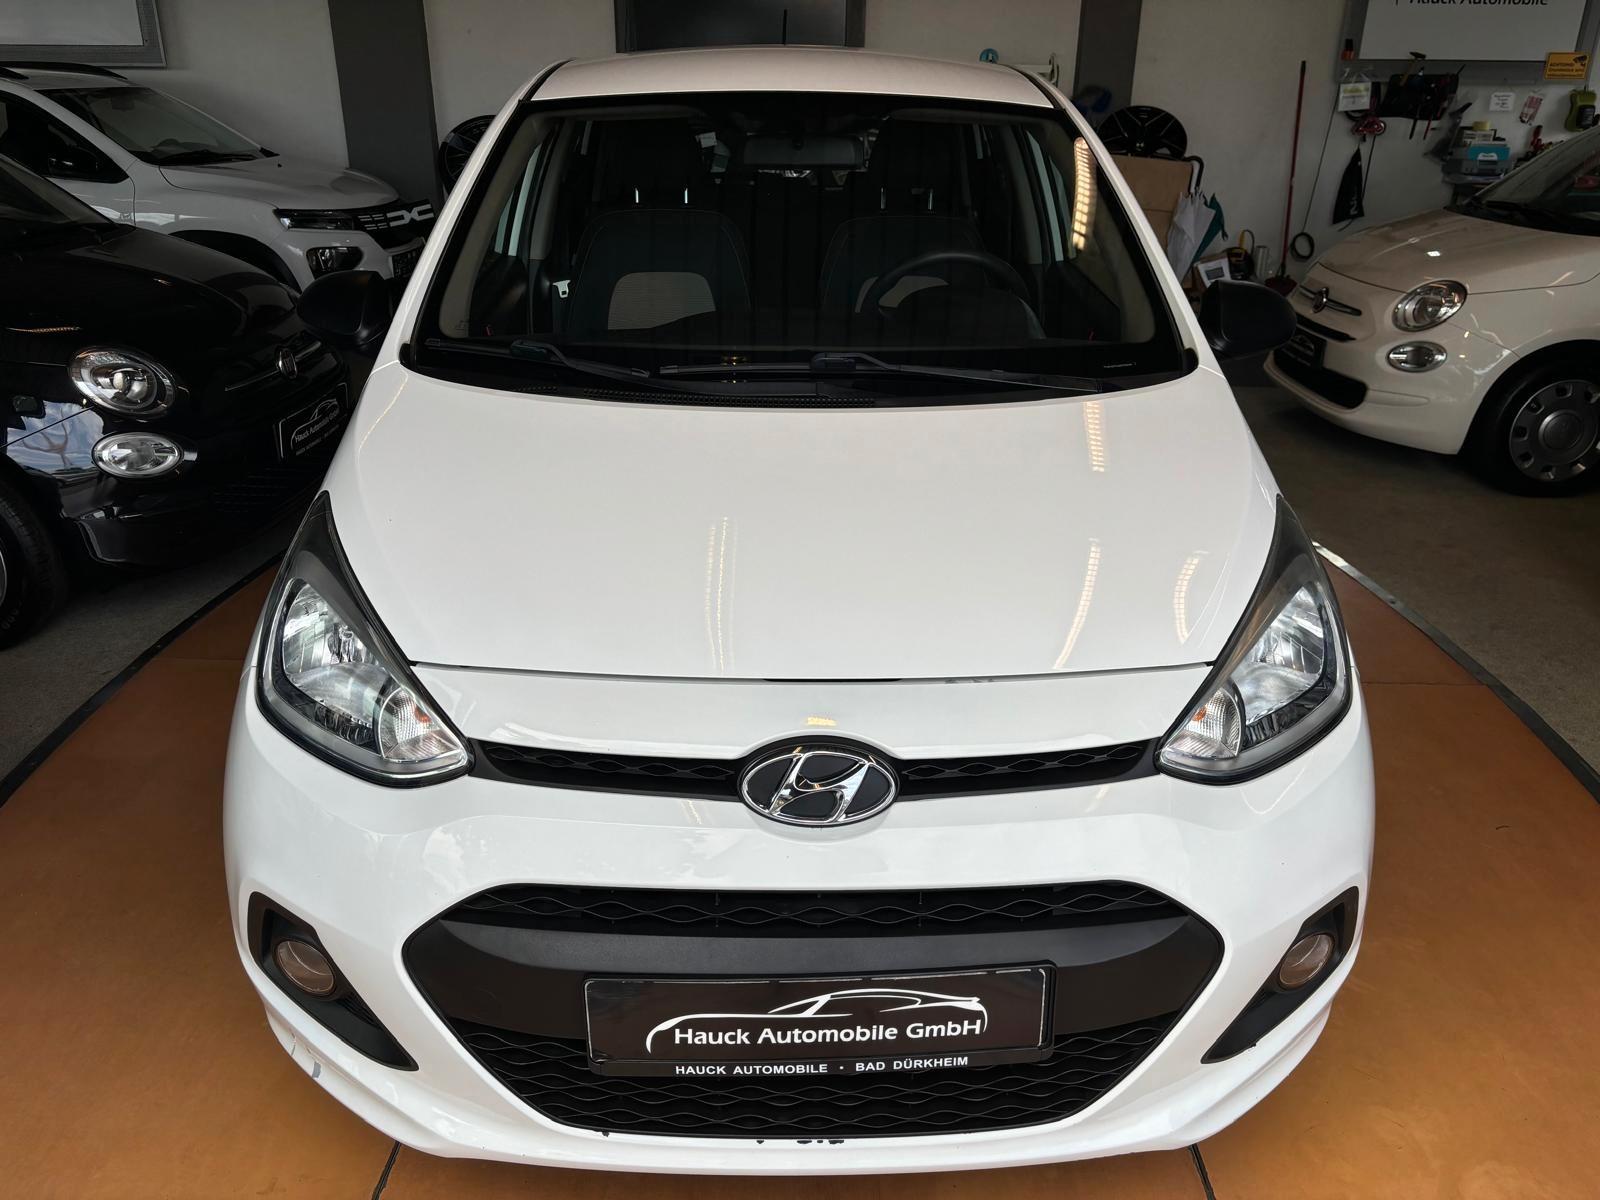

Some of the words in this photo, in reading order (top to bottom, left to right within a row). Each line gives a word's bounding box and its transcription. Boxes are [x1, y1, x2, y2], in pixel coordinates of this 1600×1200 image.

[674, 1028, 751, 1046] Hauck
[756, 1024, 899, 1045] Automobile
[905, 1019, 982, 1039] GmbH
[675, 1065, 727, 1075] HAUCK
[732, 1063, 829, 1075] AUTOMOBILE
[855, 1061, 886, 1072] BAD
[892, 1056, 969, 1070] DÜRKHEIM
